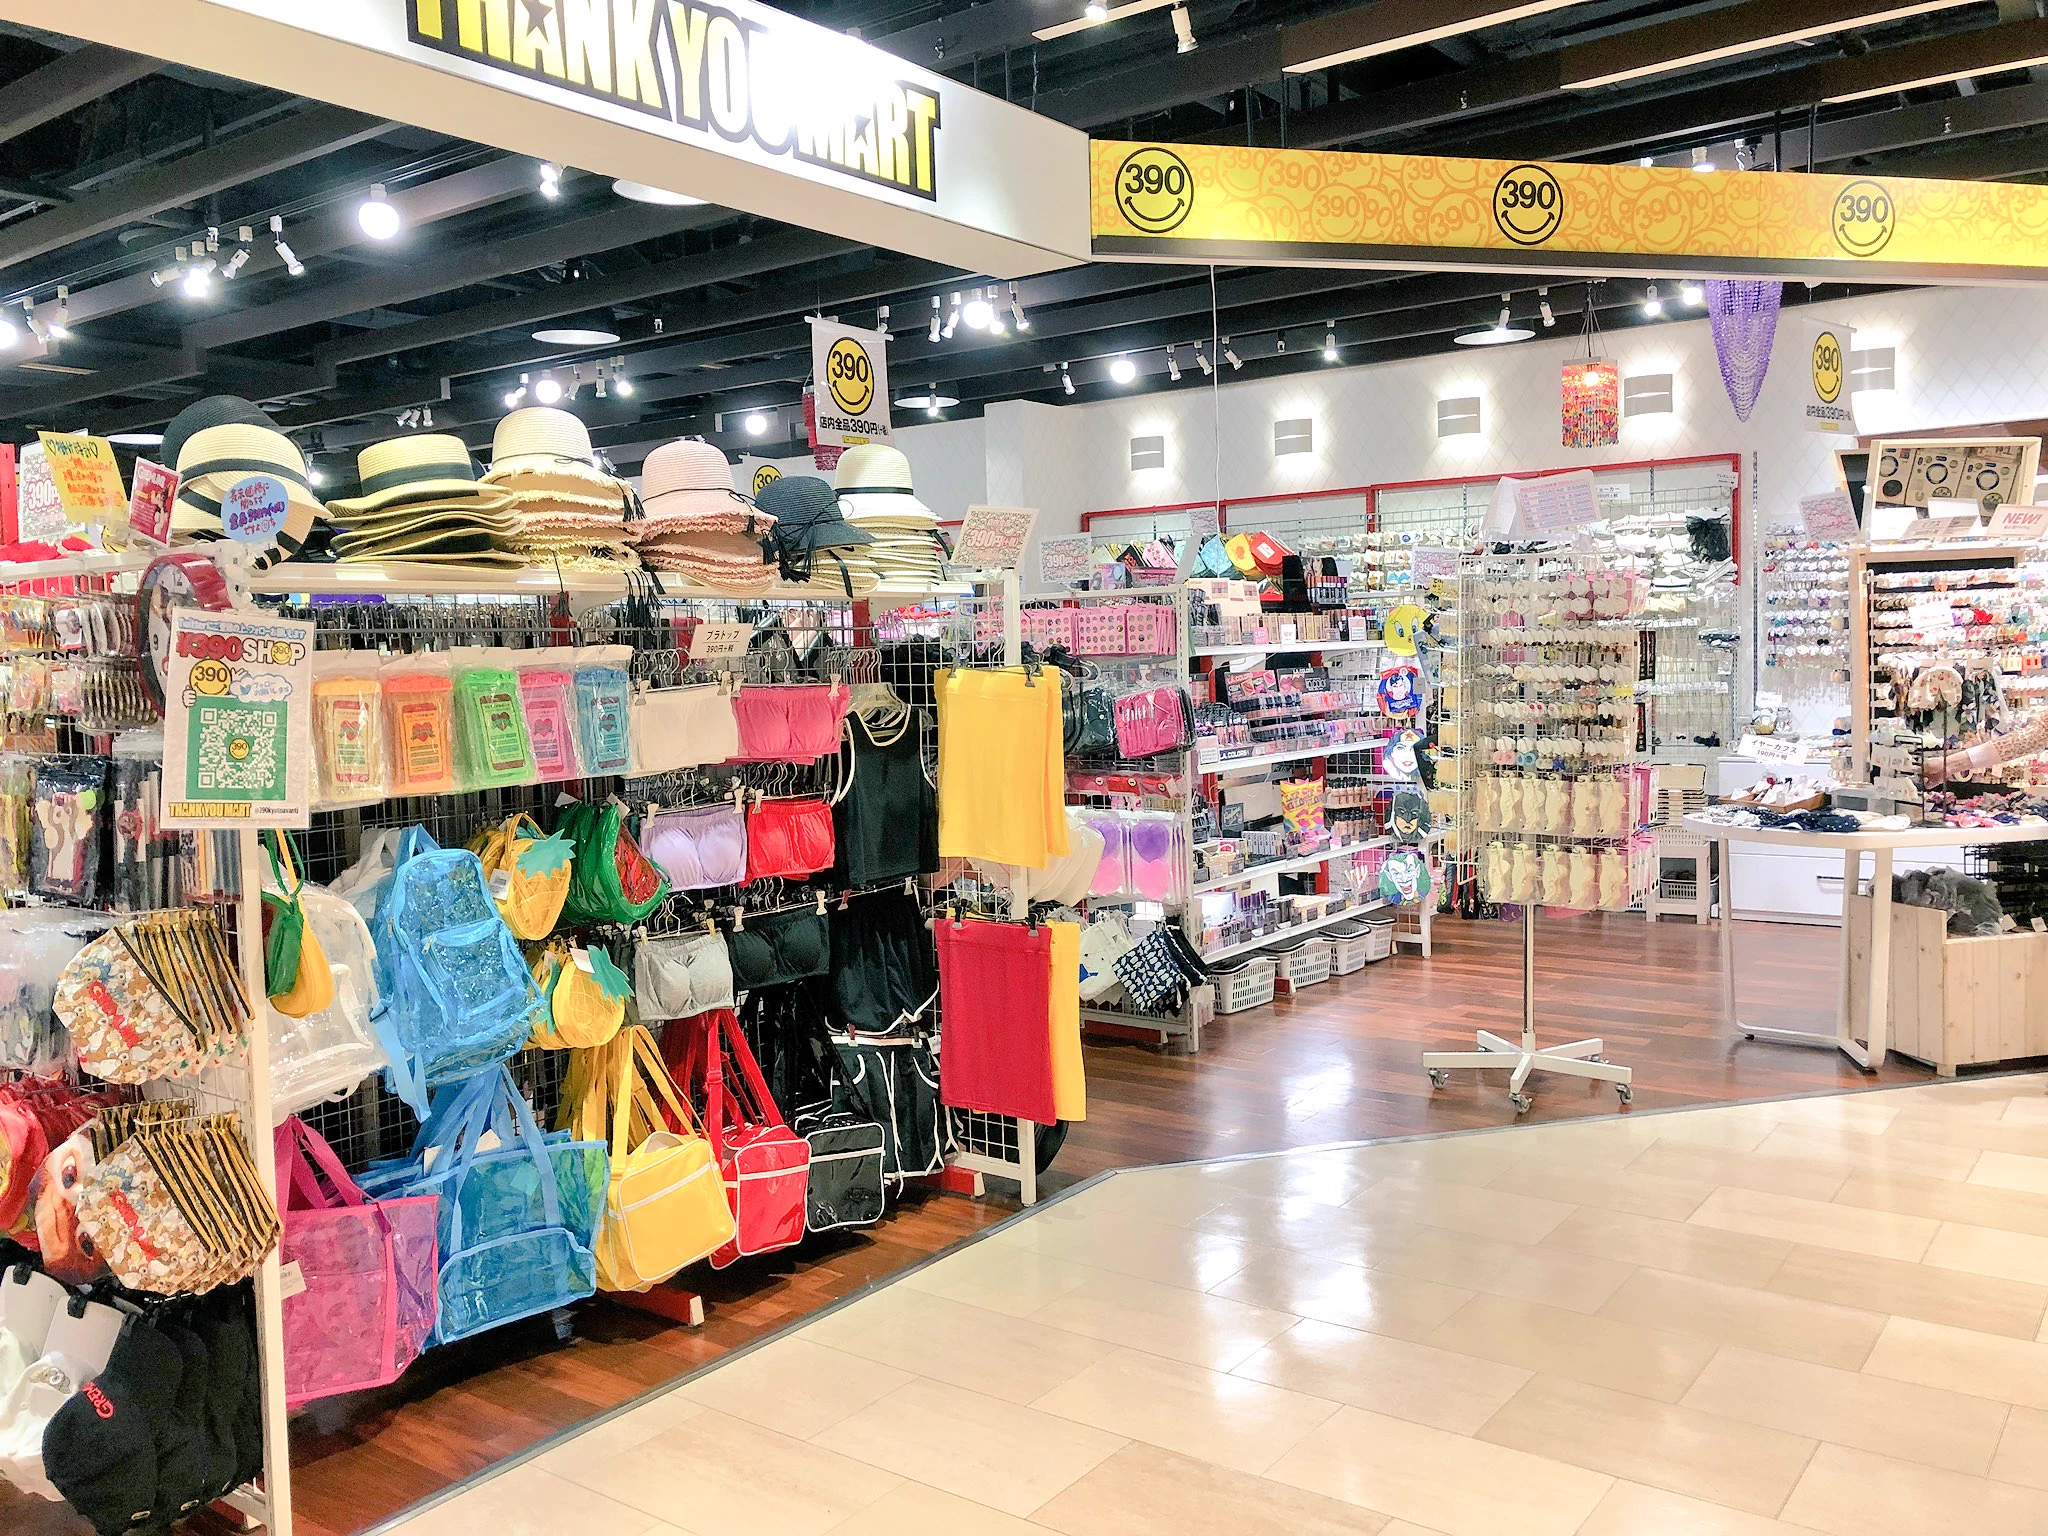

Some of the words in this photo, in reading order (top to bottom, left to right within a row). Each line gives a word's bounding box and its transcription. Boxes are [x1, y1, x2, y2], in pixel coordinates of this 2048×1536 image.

[1125, 163, 1185, 196] 390
[1502, 179, 1556, 210] 390
[1839, 195, 1889, 223] 390
[832, 350, 869, 383] 390
[1816, 345, 1839, 372] 390
[2002, 512, 2044, 526] NEW!
[706, 629, 741, 641] ブラトップ
[706, 644, 735, 653] 390円+税
[195, 666, 228, 683] 390
[231, 743, 248, 752] 390
[1751, 739, 1798, 754] イヤーカフス
